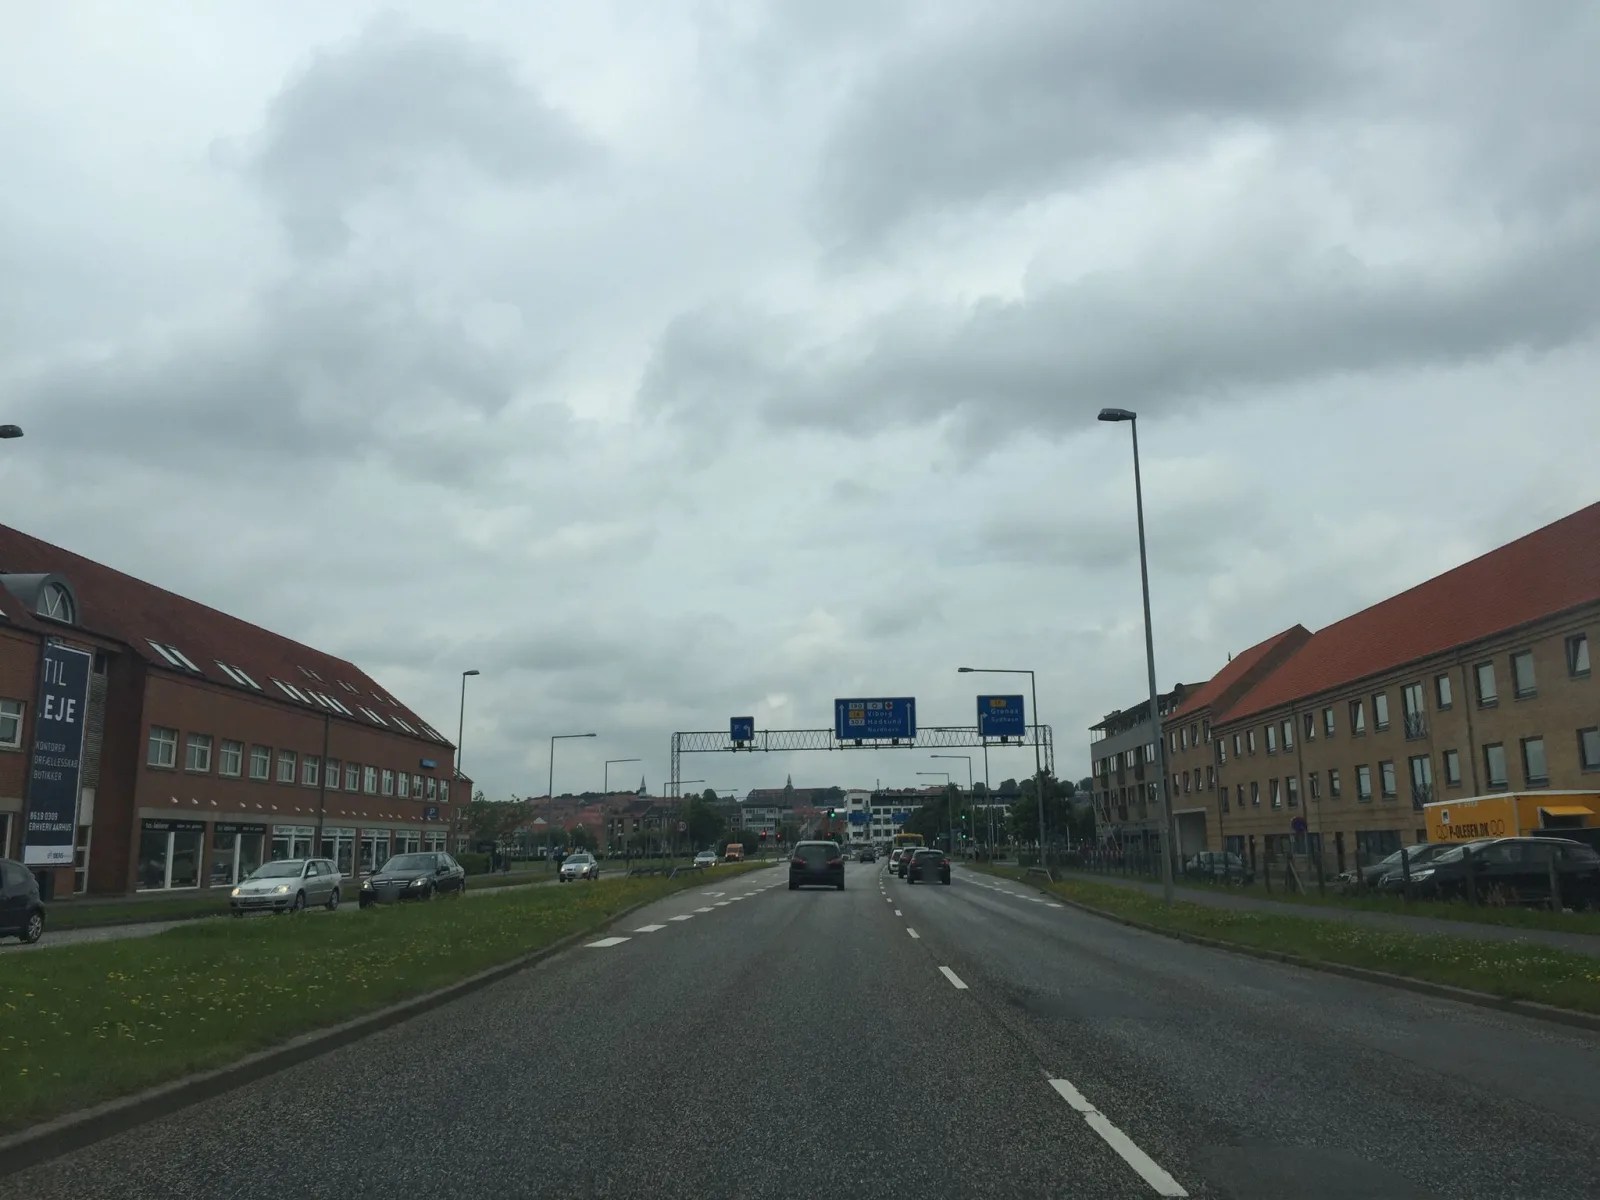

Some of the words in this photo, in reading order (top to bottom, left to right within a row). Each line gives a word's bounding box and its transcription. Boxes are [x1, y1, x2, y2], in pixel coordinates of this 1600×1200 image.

[45, 658, 67, 687] TIL
[38, 694, 76, 723] EJE
[52, 823, 73, 832] AARHUS
